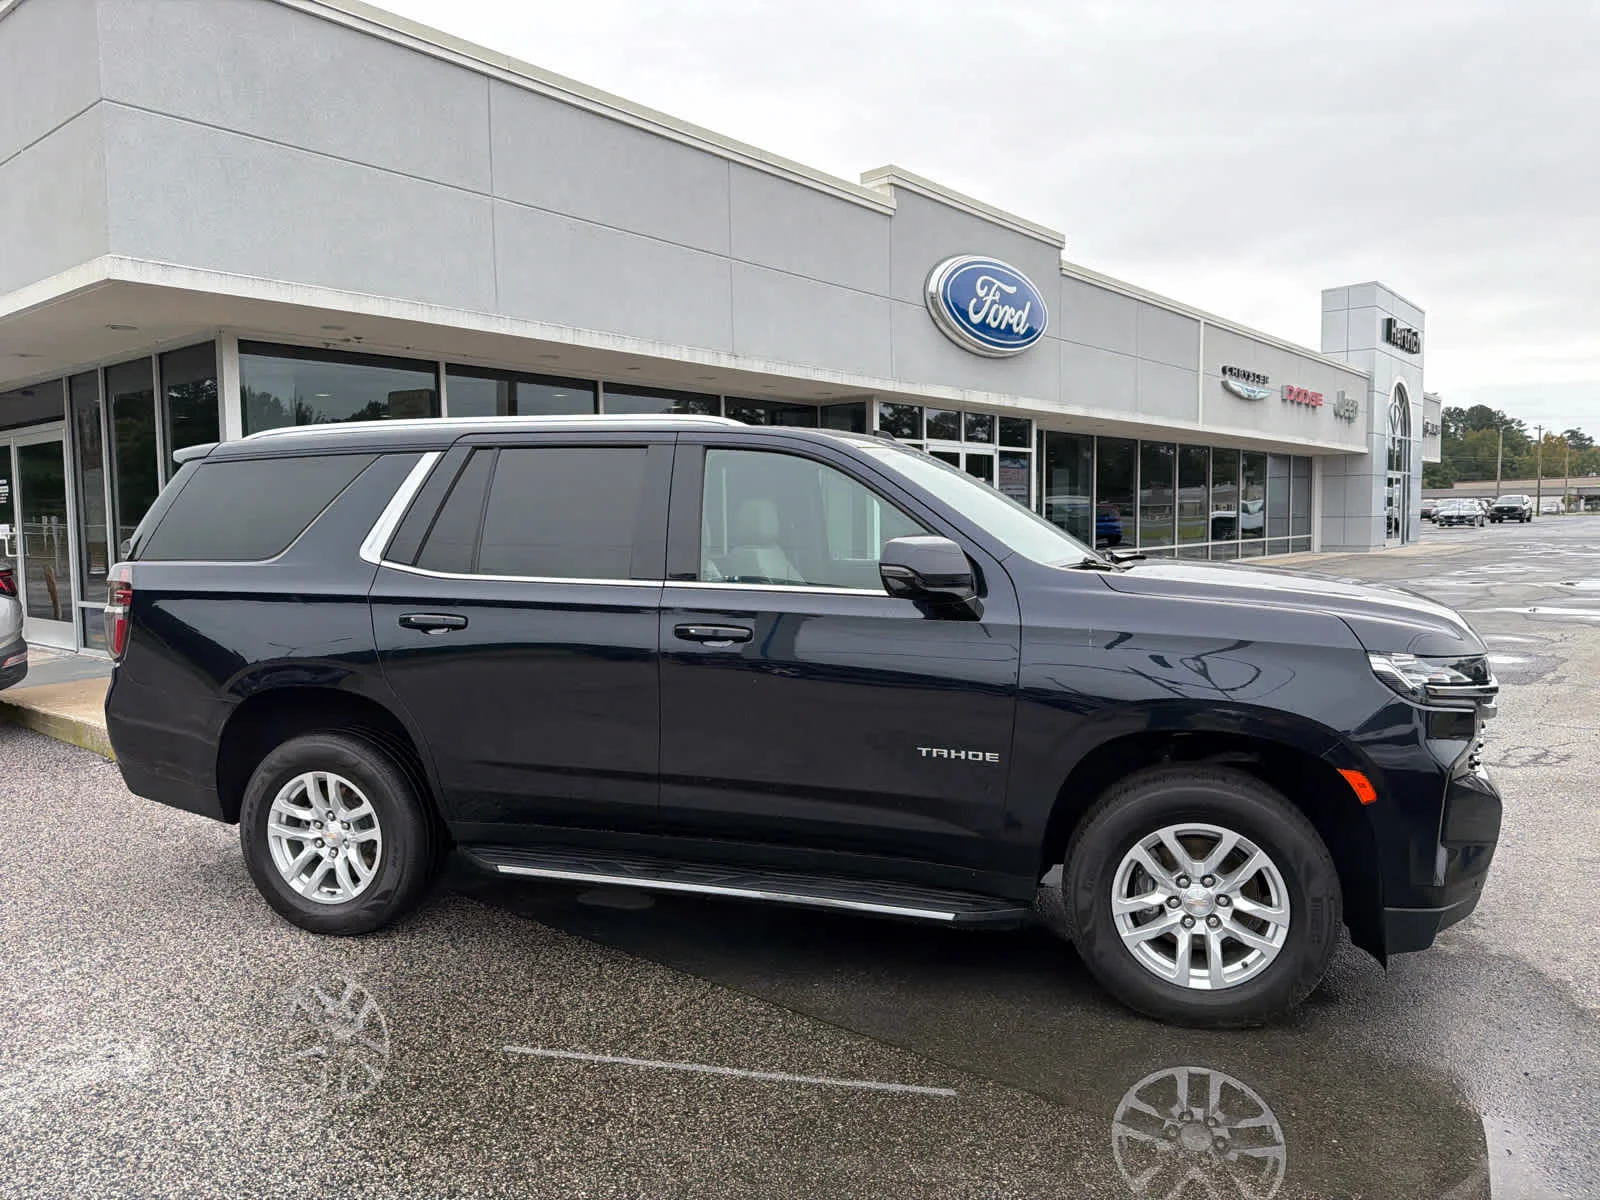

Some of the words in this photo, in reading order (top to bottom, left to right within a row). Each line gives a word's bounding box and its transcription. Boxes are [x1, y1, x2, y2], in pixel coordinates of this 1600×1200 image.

[968, 275, 1031, 335] Ford
[1281, 384, 1323, 408] DODGE
[1333, 390, 1359, 422] Jeep
[916, 747, 1000, 763] TAHOE
